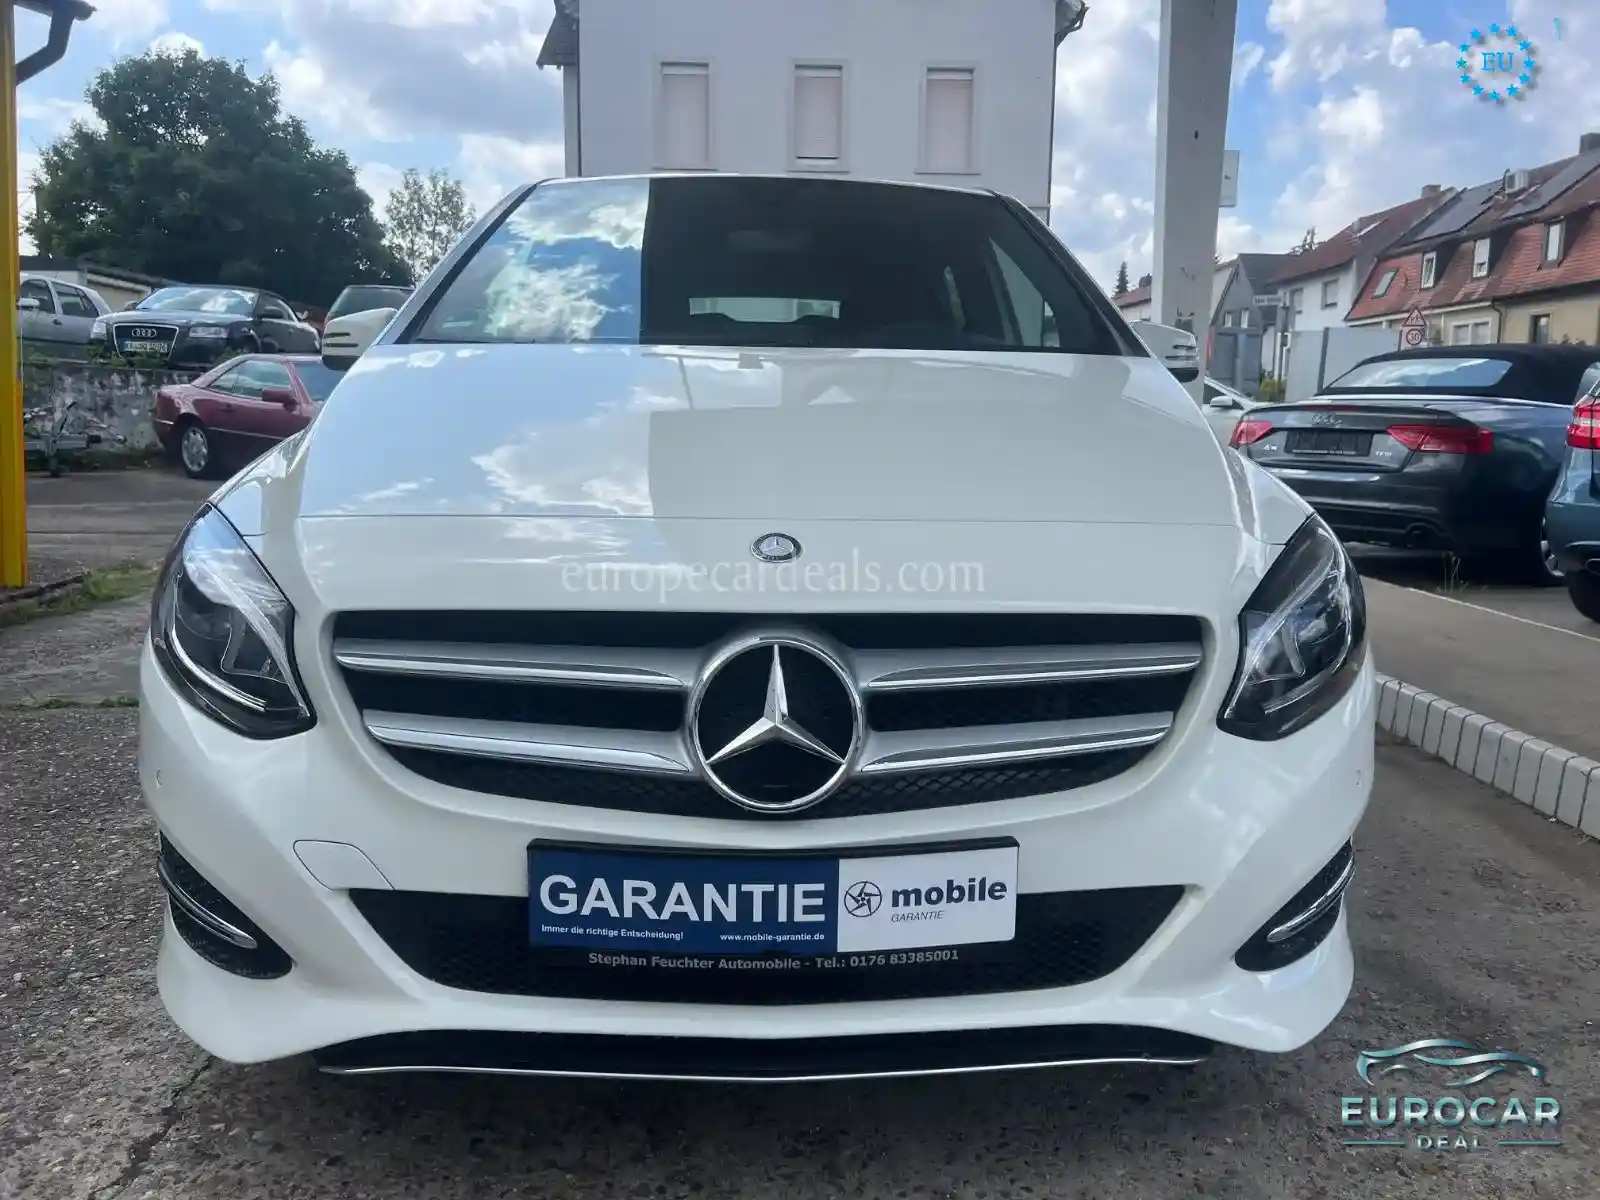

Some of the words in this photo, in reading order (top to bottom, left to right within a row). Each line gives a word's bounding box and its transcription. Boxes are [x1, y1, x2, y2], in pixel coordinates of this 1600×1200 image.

[540, 874, 826, 922] GARANTIE
[891, 876, 1008, 908] mobile
[890, 910, 945, 922] GARANTIE
[541, 924, 569, 933] Immer
[571, 926, 584, 934] die
[586, 928, 618, 937] richtige
[621, 929, 684, 940] Entscheidung!
[720, 932, 825, 942] www.mobile-garantie.de
[588, 953, 647, 967] Stephan
[651, 956, 714, 969] Feuchter
[718, 958, 801, 970] Automobile
[815, 957, 846, 968] Tel.:
[850, 954, 886, 967] 0176
[890, 950, 959, 965] 83385001
